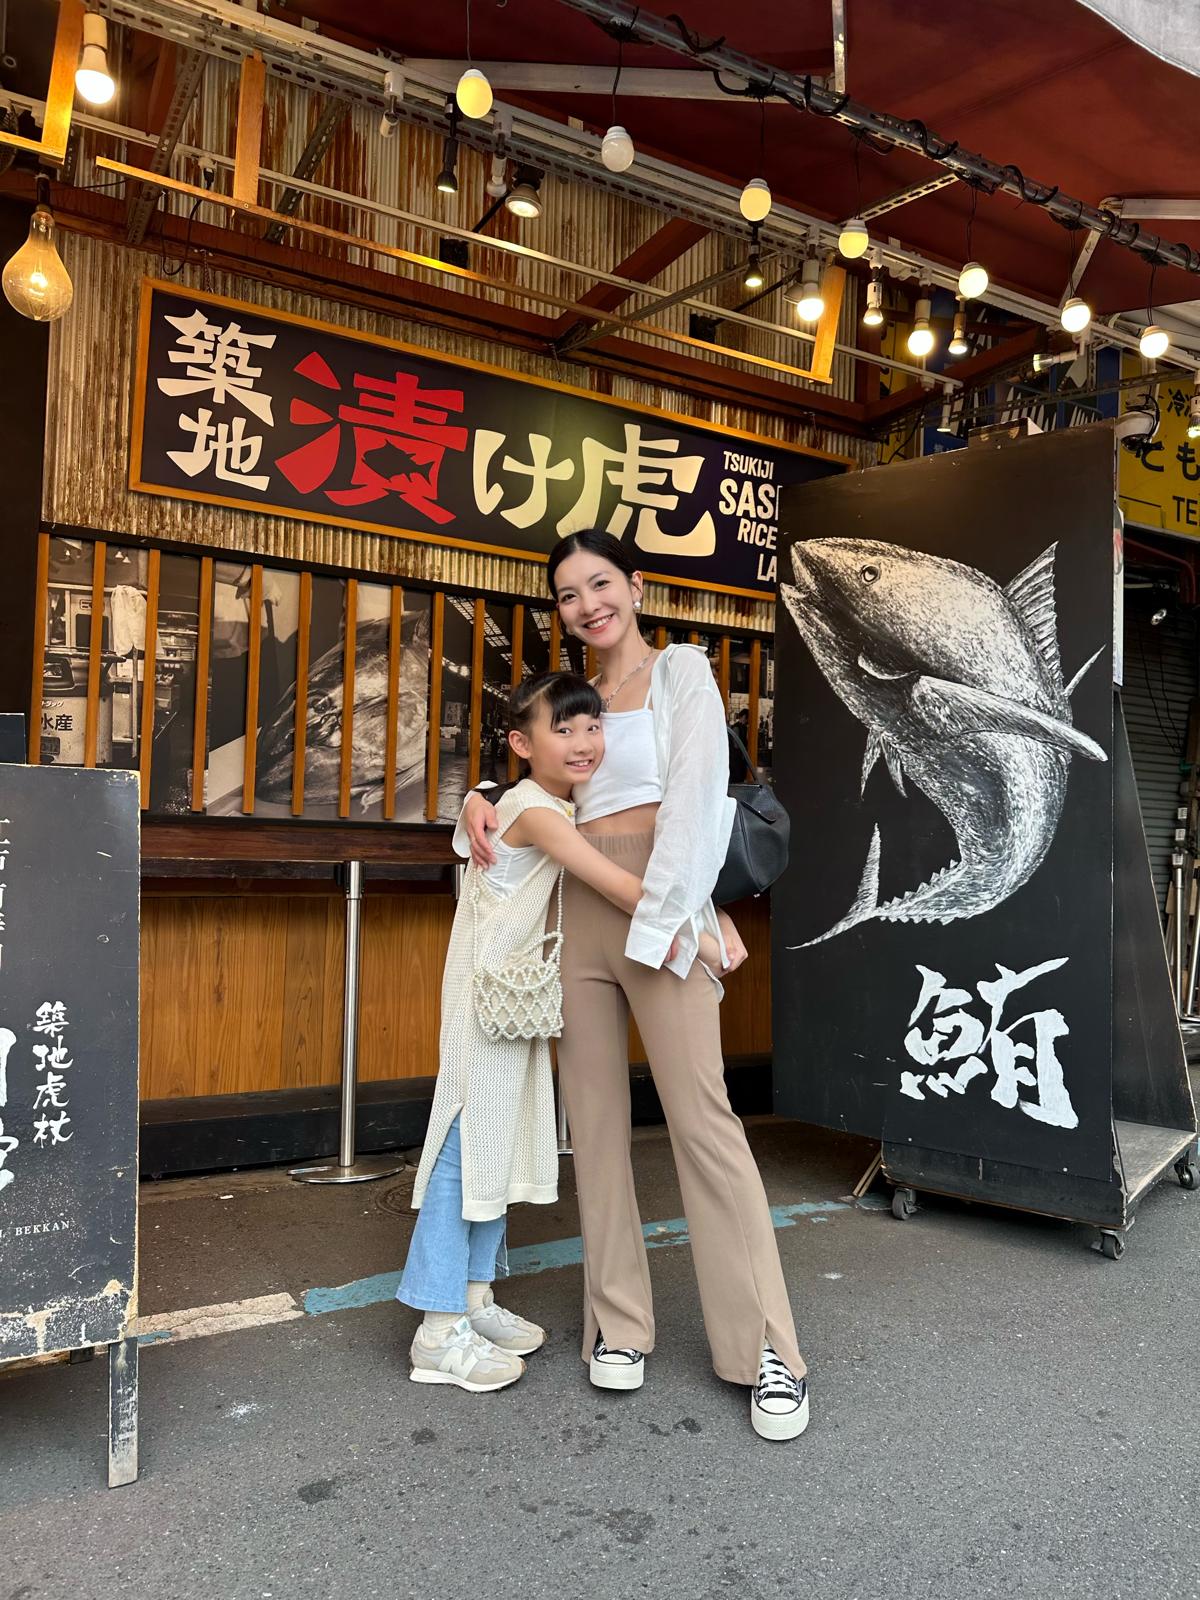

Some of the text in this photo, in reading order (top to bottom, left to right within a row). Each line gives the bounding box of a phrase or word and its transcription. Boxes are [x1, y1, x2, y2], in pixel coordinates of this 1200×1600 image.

[157, 309, 277, 492] 築地
[275, 351, 716, 557] 漬け虎
[723, 451, 775, 480] TSUKIJI
[737, 518, 779, 550] RICE
[33, 1001, 73, 1149] 築地虎杖
[900, 957, 1079, 1129] 鮪
[15, 1220, 70, 1236] BEKKAN
